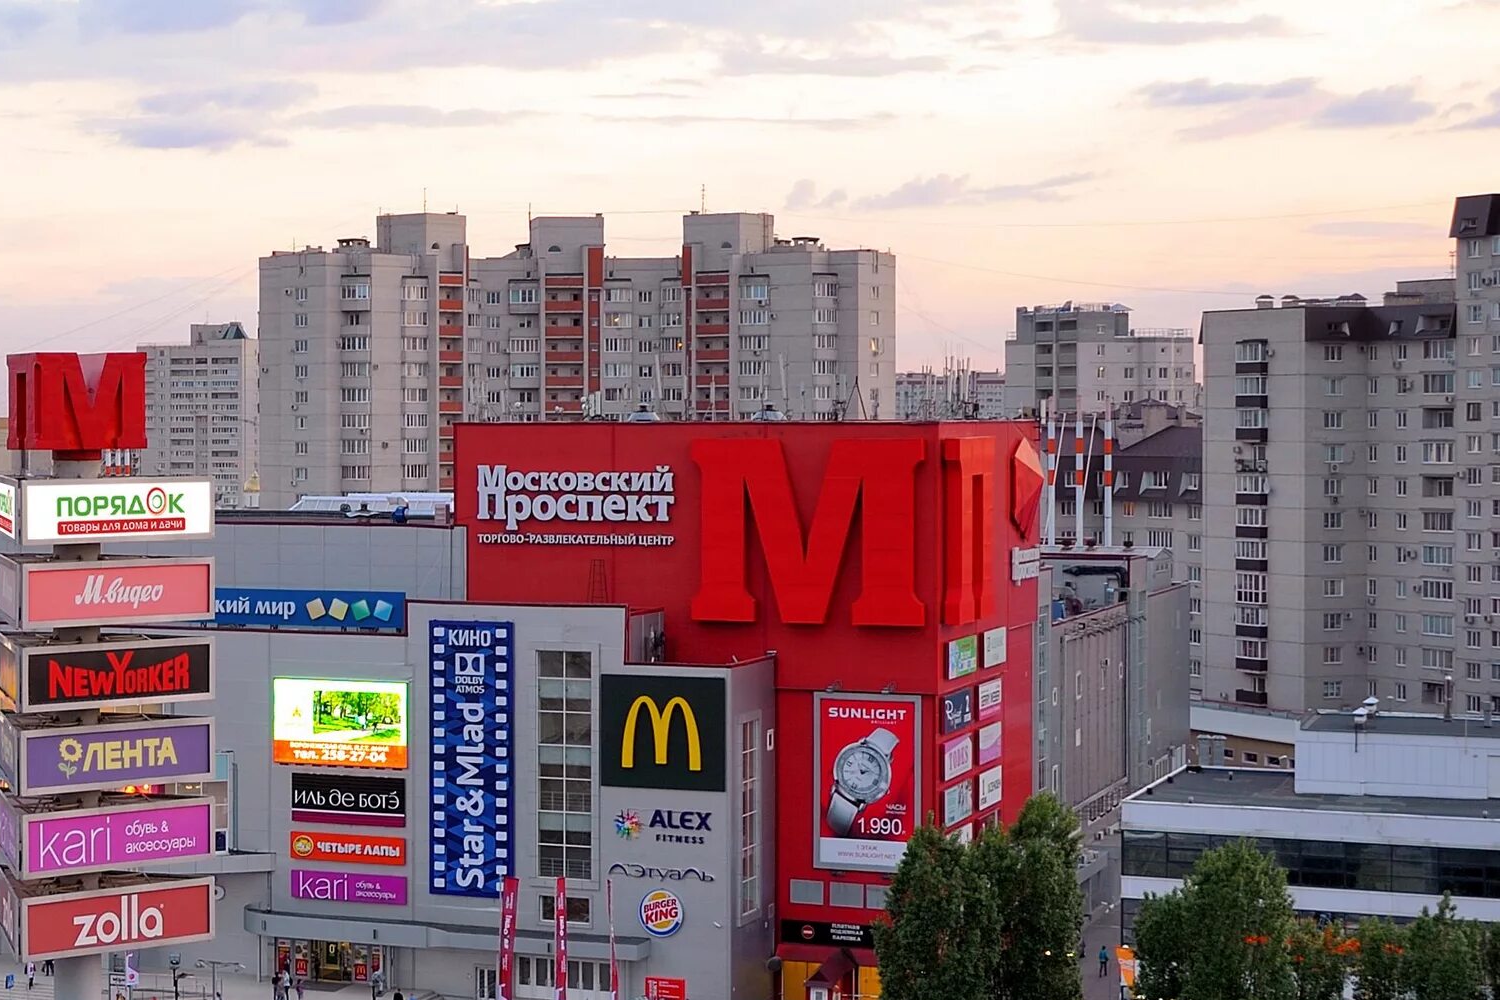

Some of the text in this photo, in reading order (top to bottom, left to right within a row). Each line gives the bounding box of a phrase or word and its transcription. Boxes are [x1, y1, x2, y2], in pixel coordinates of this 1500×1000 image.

[477, 464, 674, 492] Московский
[56, 487, 186, 518] ПОРЯДОК
[476, 491, 675, 531] Проспект
[60, 515, 184, 535] товары для дома и дачи
[477, 533, 675, 547] ТОРГОВО-РАЗВЛЕКАТЕЛЬНЫЙ ЦЕНТР
[75, 574, 165, 609] М.видео
[255, 599, 296, 619] мир
[448, 629, 491, 647] КИНО
[455, 676, 485, 684] DOLBY
[455, 685, 485, 694] ATMOS
[828, 707, 907, 720] SUNLIGHT
[83, 737, 178, 771] ЛЕНТА
[456, 702, 485, 889] Star&Mlad
[886, 803, 907, 811] ЧАСЫ
[125, 820, 158, 836] обувь
[649, 810, 712, 831] ALEX
[857, 817, 901, 835] 1.990
[39, 816, 111, 868] kari
[125, 836, 196, 854] аксессуары
[656, 834, 704, 844] FITNESS
[317, 842, 400, 857] ЧЕТЫРЕ ЛАПЫ
[299, 871, 347, 900] kari
[643, 899, 677, 913] BURGER
[73, 894, 163, 946] zolla
[644, 908, 678, 924] KING
